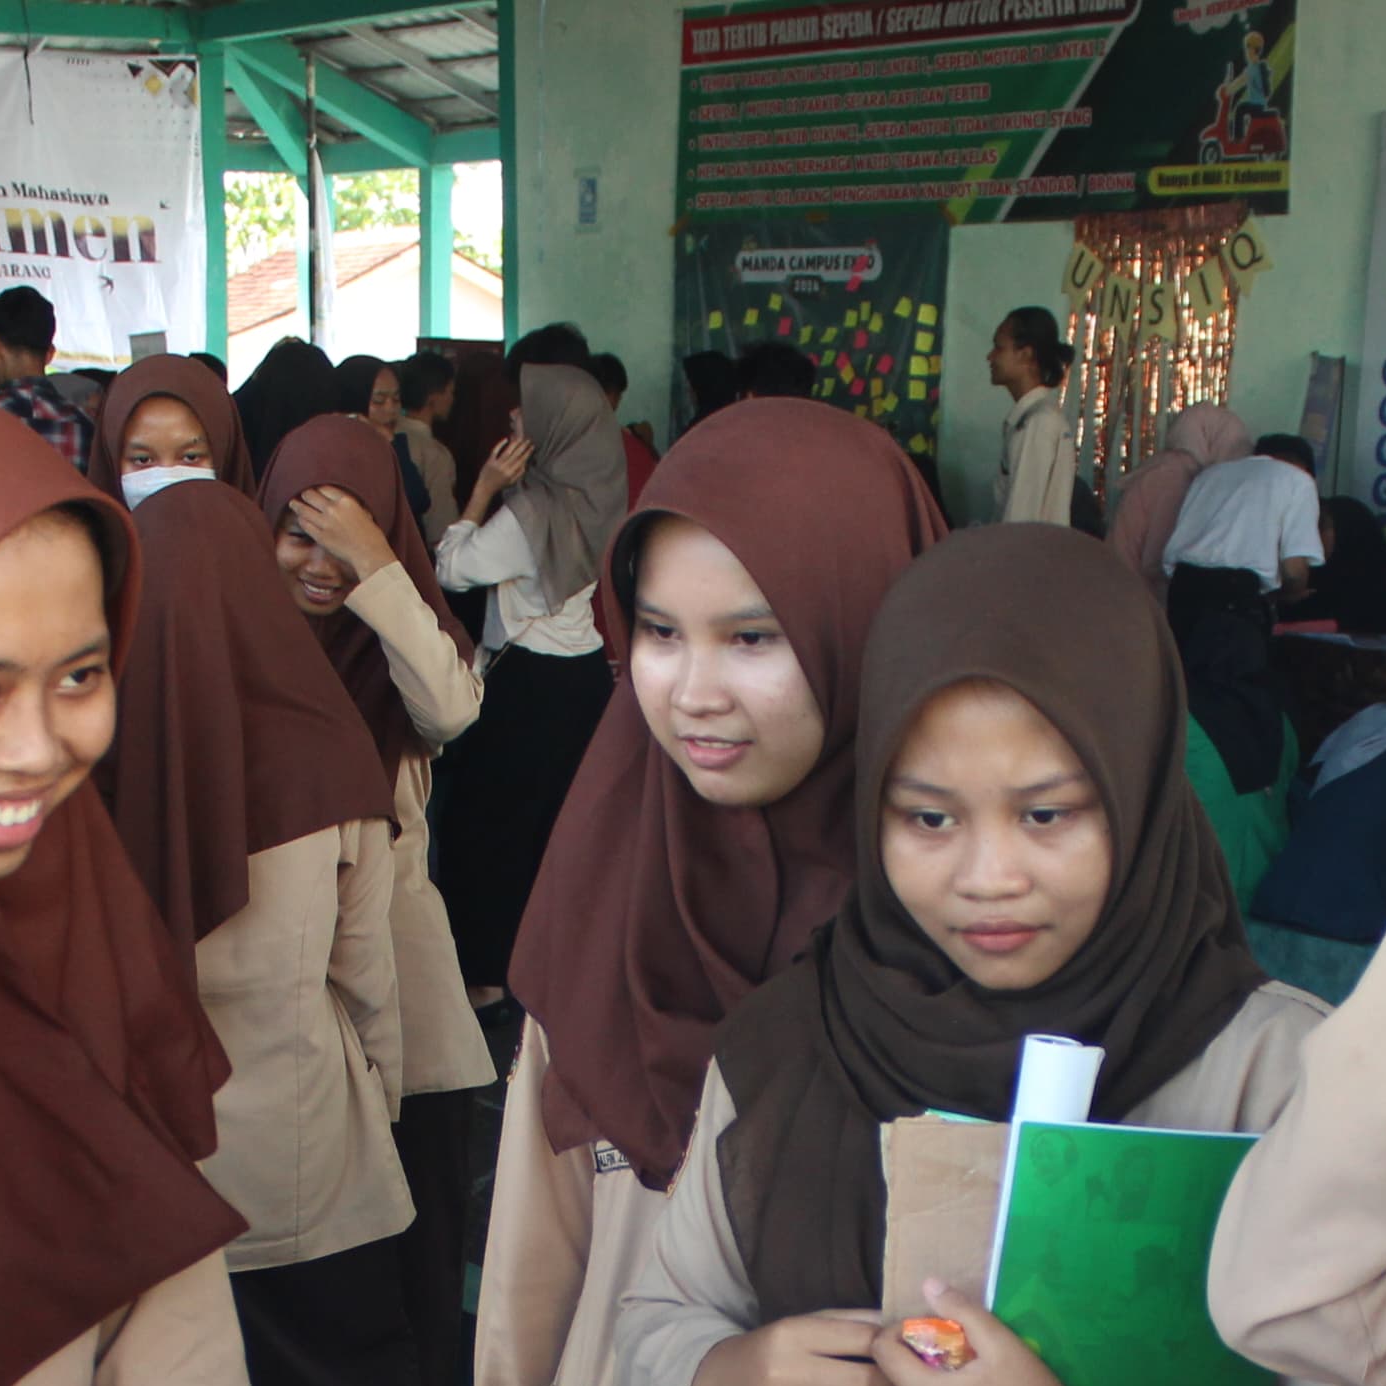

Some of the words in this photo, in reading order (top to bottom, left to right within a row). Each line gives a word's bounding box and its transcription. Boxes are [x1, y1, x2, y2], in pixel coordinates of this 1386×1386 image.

[770, 16, 819, 46] PARKIR
[822, 9, 873, 41] SEPEDA
[886, 2, 943, 34] SEPEDA
[944, 0, 1001, 28] MOTOR
[1004, 0, 1076, 22] PESERTA
[934, 50, 980, 71] SEPEDA
[983, 47, 1028, 66] MOTOR
[864, 121, 907, 139] SEPEDA
[909, 117, 951, 135] MOTOR
[991, 111, 1047, 130] DIKUNCI
[1050, 107, 1093, 128] STANG
[963, 147, 999, 165] KELAS
[13, 181, 110, 206] Mahasiswa
[975, 179, 1013, 197] TIDAK
[1016, 176, 1078, 195] STANDAR
[741, 256, 785, 271] MANDA
[789, 255, 840, 271] CAMPUS
